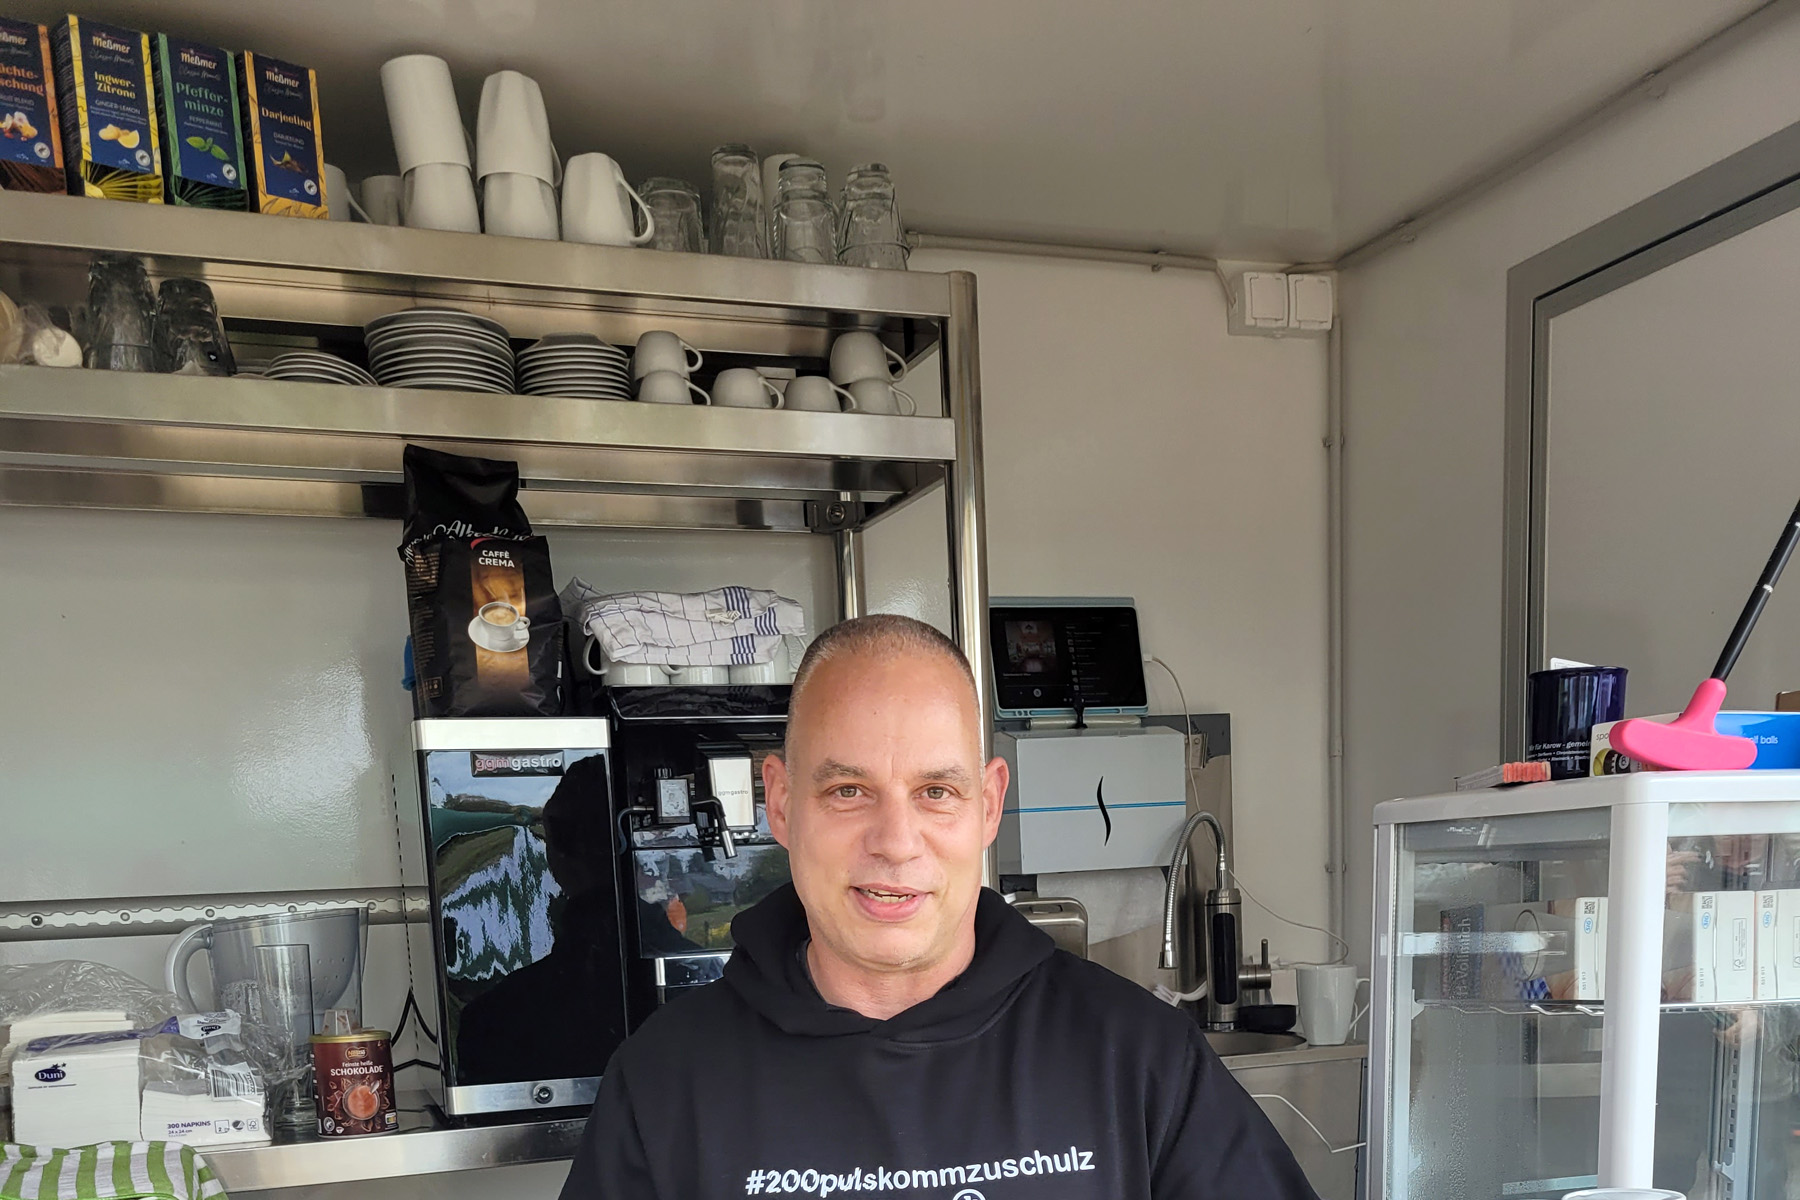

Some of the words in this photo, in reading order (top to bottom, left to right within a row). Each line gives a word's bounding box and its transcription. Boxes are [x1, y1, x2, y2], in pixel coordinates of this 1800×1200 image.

[92, 35, 131, 54] Meßmer
[180, 51, 218, 70] Meßmer
[94, 71, 136, 88] Ingwer-
[265, 70, 300, 88] Meßmer
[96, 81, 136, 99] Zitrone
[176, 81, 229, 103] Pfeffer-
[184, 99, 224, 118] minze
[261, 106, 312, 131] Darjeeling
[478, 557, 516, 568] CREMA
[1760, 735, 1779, 745] balls
[38, 1070, 63, 1080] Duni
[330, 1065, 384, 1077] SCHOKOLADE
[180, 1121, 211, 1129] NAPKINS
[745, 1146, 1096, 1199] #200pulskommzuschulz
